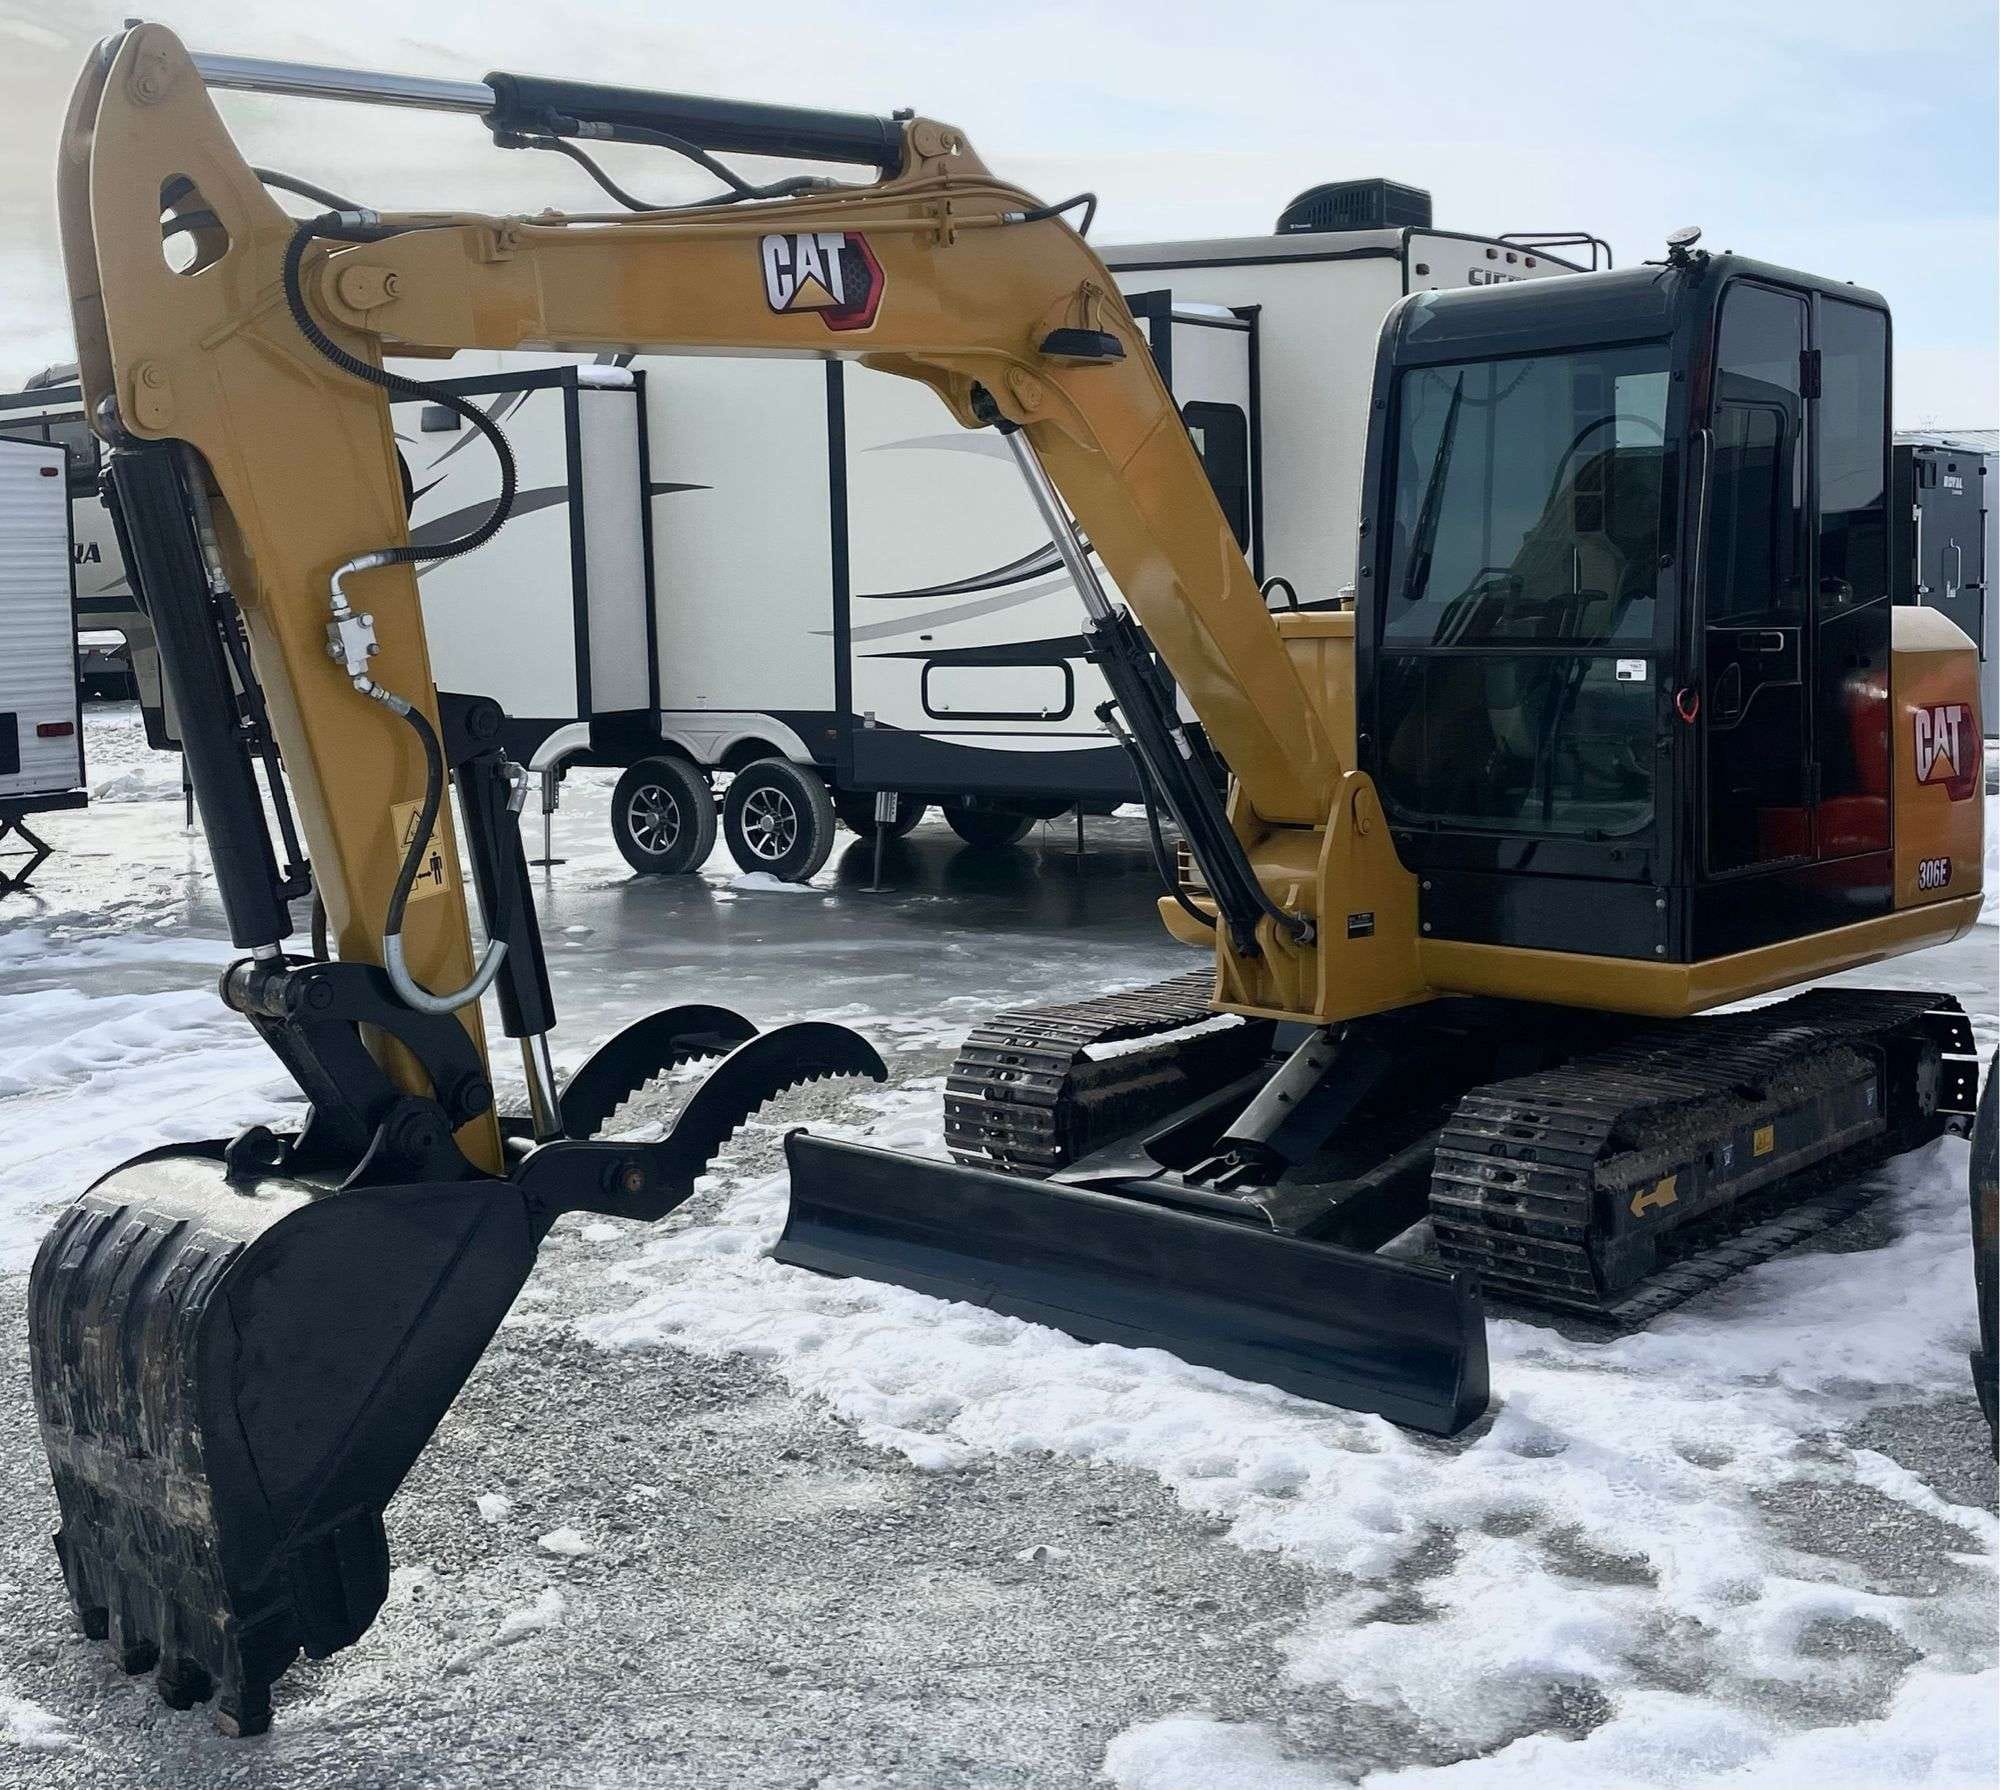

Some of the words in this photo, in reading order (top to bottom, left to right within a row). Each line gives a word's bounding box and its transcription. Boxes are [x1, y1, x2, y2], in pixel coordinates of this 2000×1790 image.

[762, 232, 846, 311] CAT
[1915, 705, 1962, 782] CAT
[1919, 858, 1948, 889] 306E
